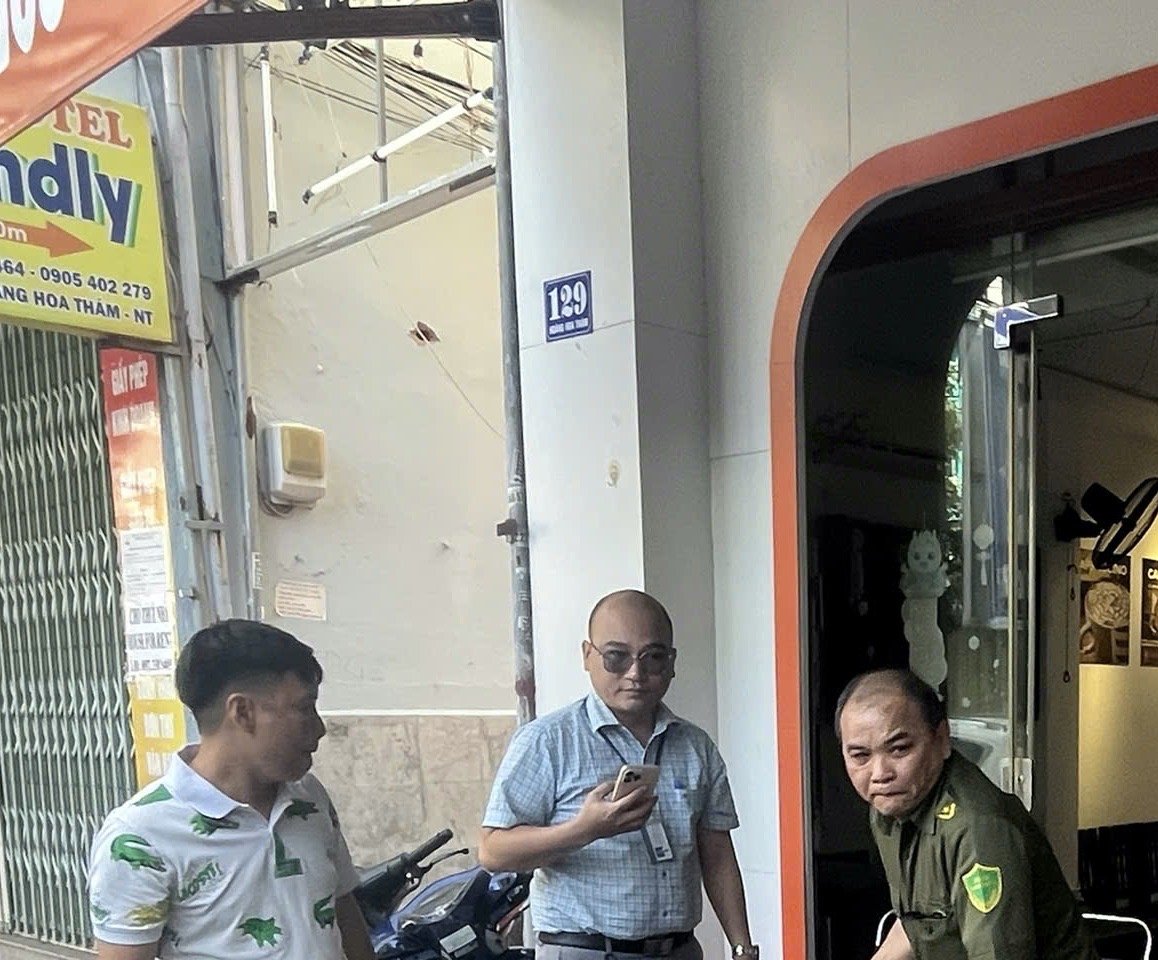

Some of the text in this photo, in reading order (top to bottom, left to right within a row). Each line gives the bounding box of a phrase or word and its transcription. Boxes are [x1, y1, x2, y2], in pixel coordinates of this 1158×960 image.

[0, 142, 138, 246] ndly
[0, 259, 25, 277] 64
[40, 266, 82, 287] 0905
[87, 275, 118, 294] 402
[122, 282, 152, 300] 279
[33, 291, 70, 311] HOA
[134, 309, 153, 326] NT
[548, 281, 587, 321] 129
